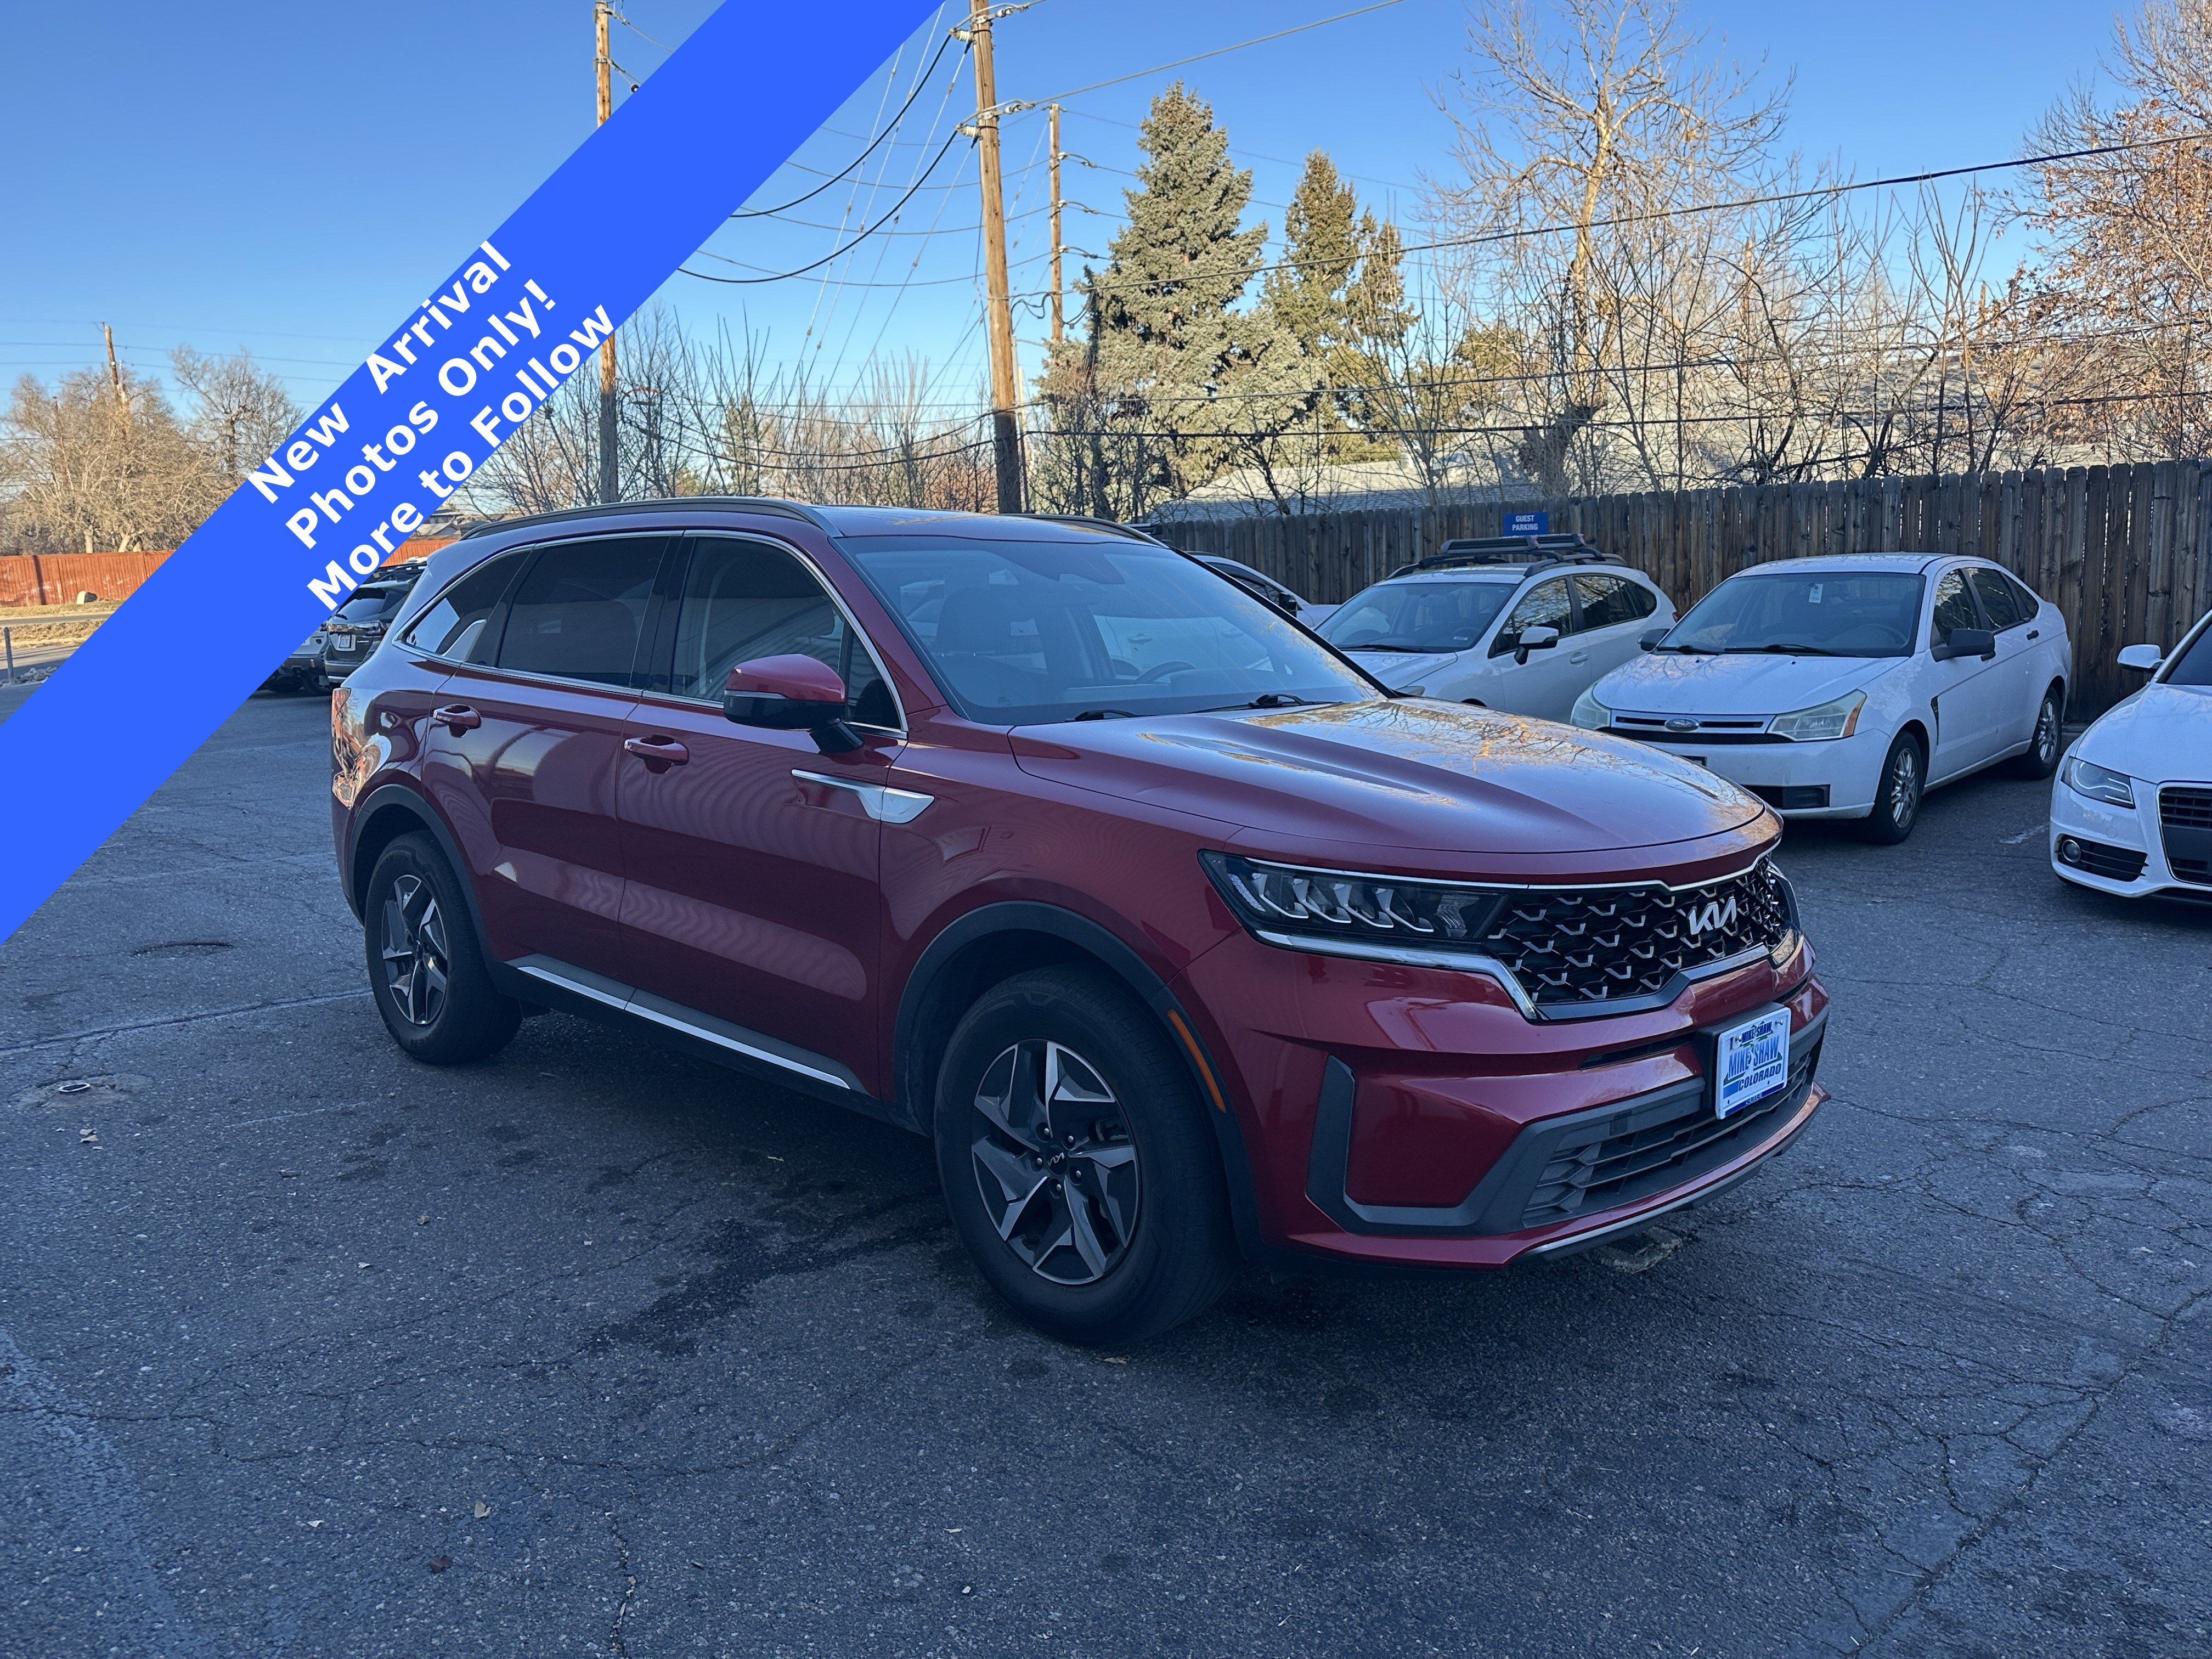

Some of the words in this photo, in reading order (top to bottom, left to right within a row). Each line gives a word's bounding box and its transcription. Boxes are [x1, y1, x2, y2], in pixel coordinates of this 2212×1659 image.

[1512, 523, 1538, 531] PARKING
[1742, 1028, 1754, 1043] MIKE
[1756, 1022, 1772, 1037] SHAW
[1729, 1047, 1752, 1078] MIKE
[1753, 1035, 1780, 1066] SHAW
[1738, 1063, 1781, 1091] COLORADO
